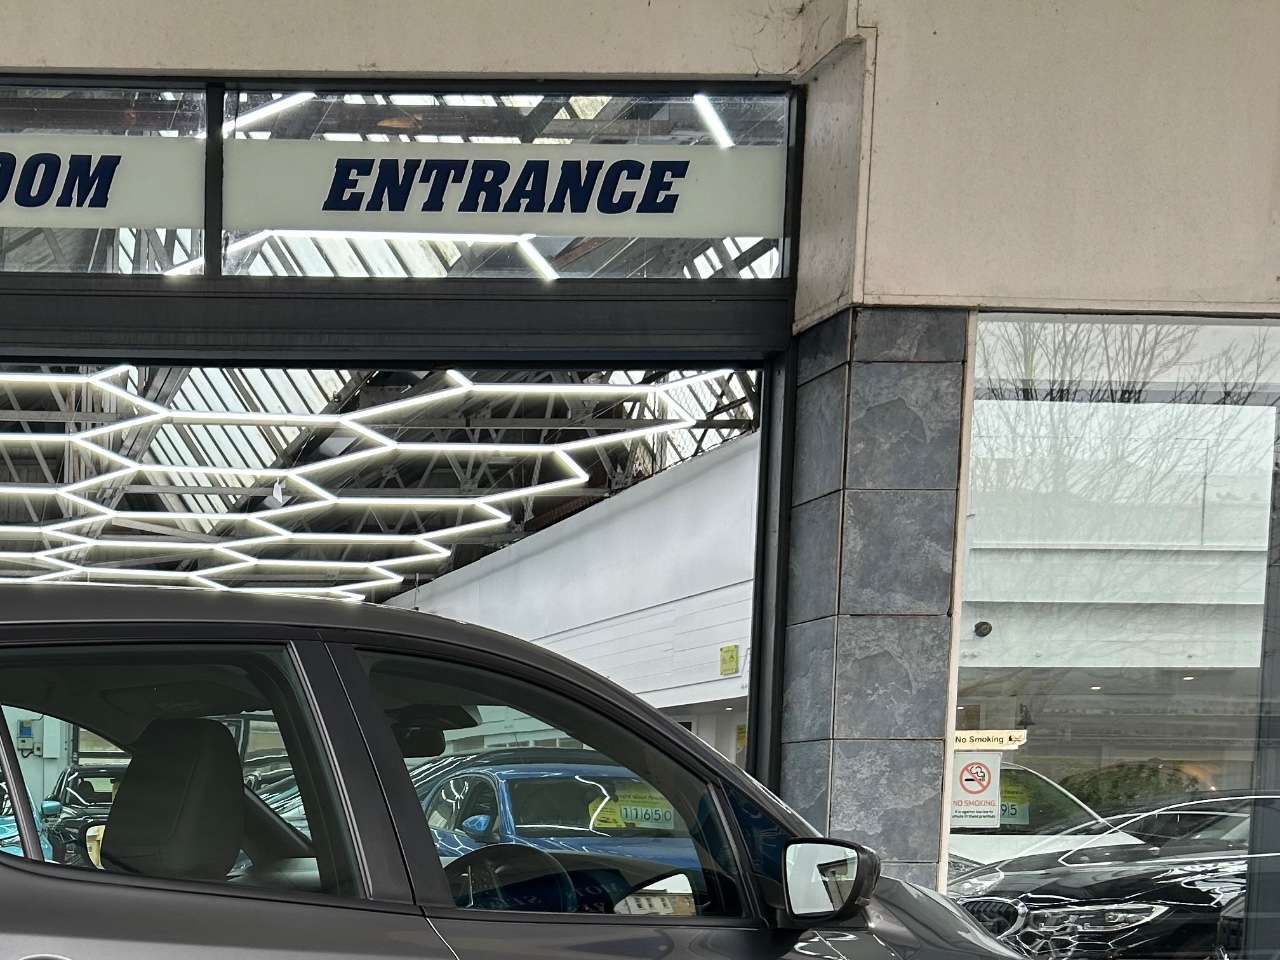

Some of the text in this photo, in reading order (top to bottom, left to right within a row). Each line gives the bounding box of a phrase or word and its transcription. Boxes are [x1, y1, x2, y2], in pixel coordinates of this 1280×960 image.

[322, 158, 690, 214] ENTRANCE
[955, 735, 1004, 744] No Smoking
[952, 799, 963, 807] NO
